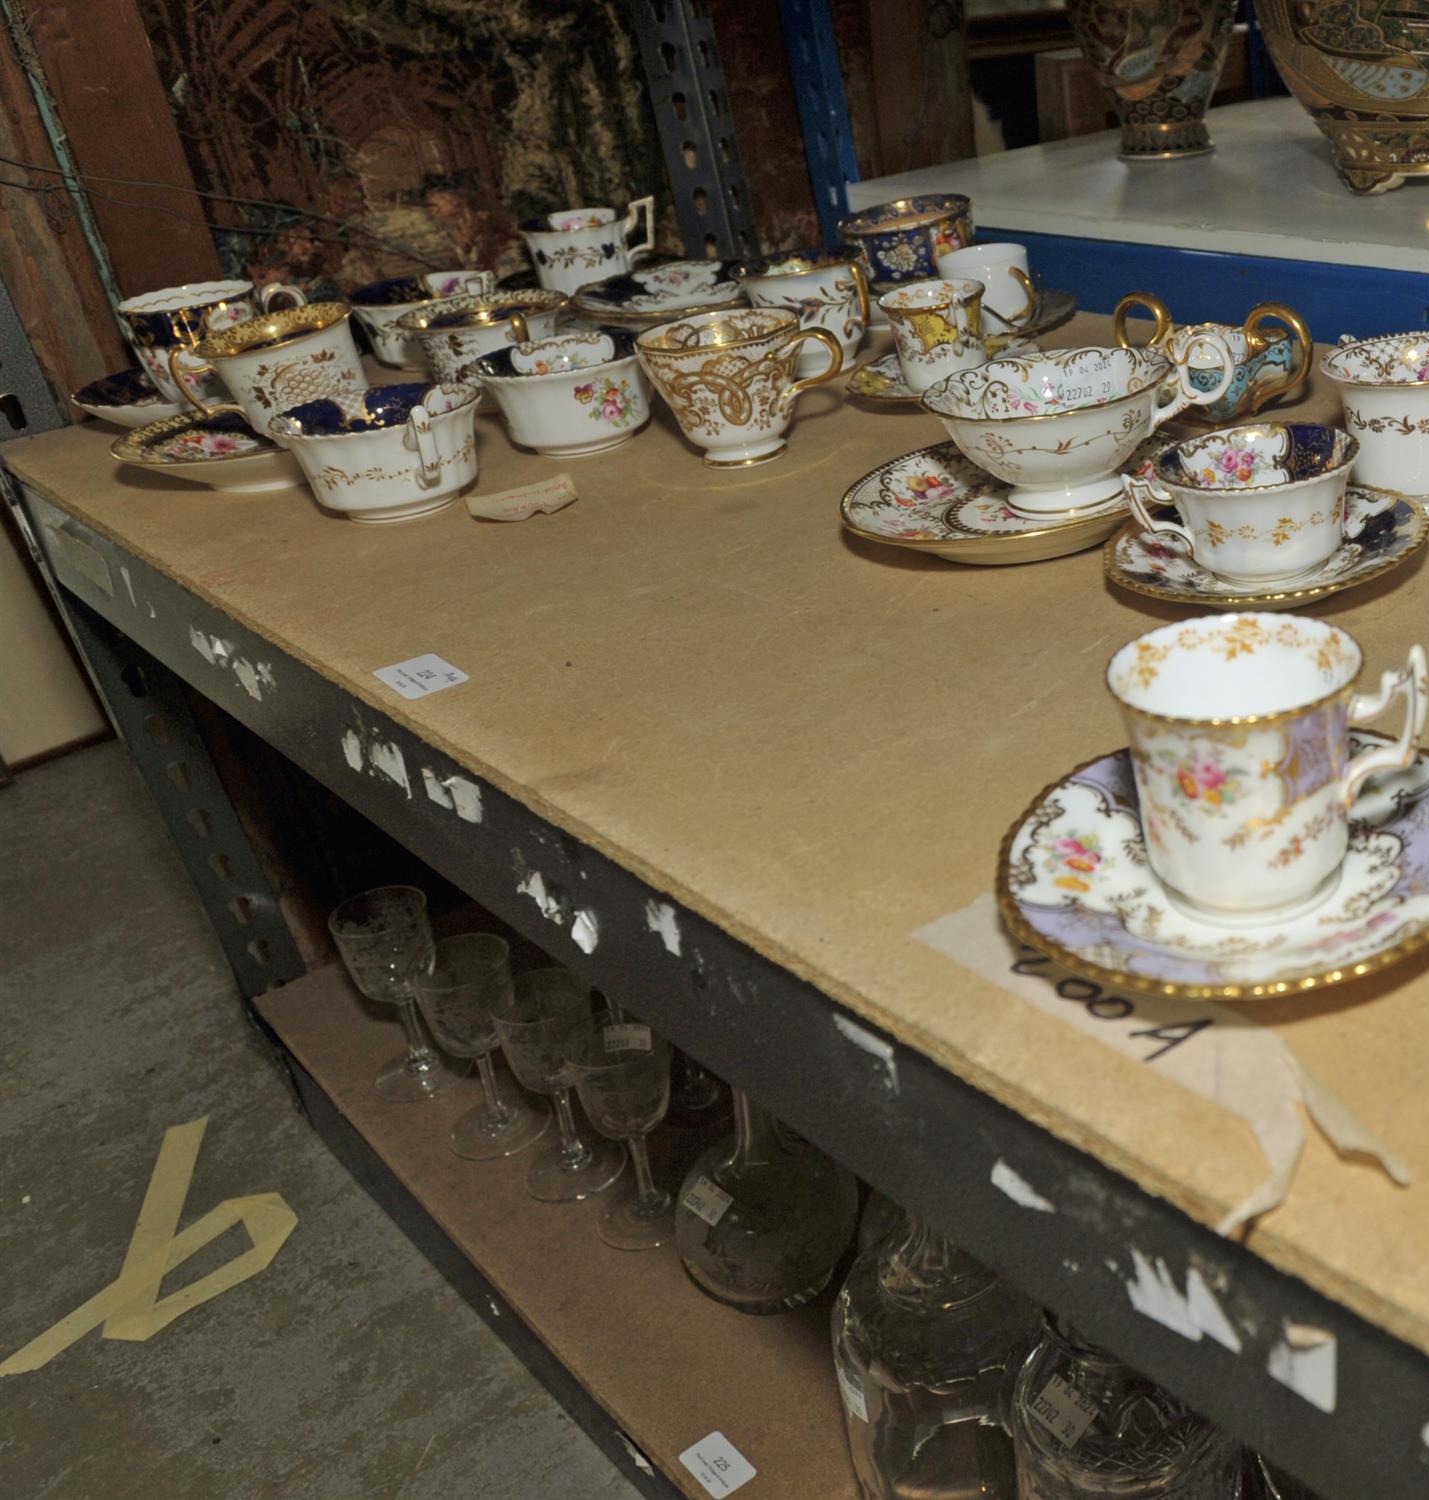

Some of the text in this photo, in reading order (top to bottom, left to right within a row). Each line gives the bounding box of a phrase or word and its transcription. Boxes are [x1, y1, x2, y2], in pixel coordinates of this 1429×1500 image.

[1063, 368, 1073, 377] 19
[1066, 386, 1093, 401] 22702
[713, 1457, 731, 1472] 225
